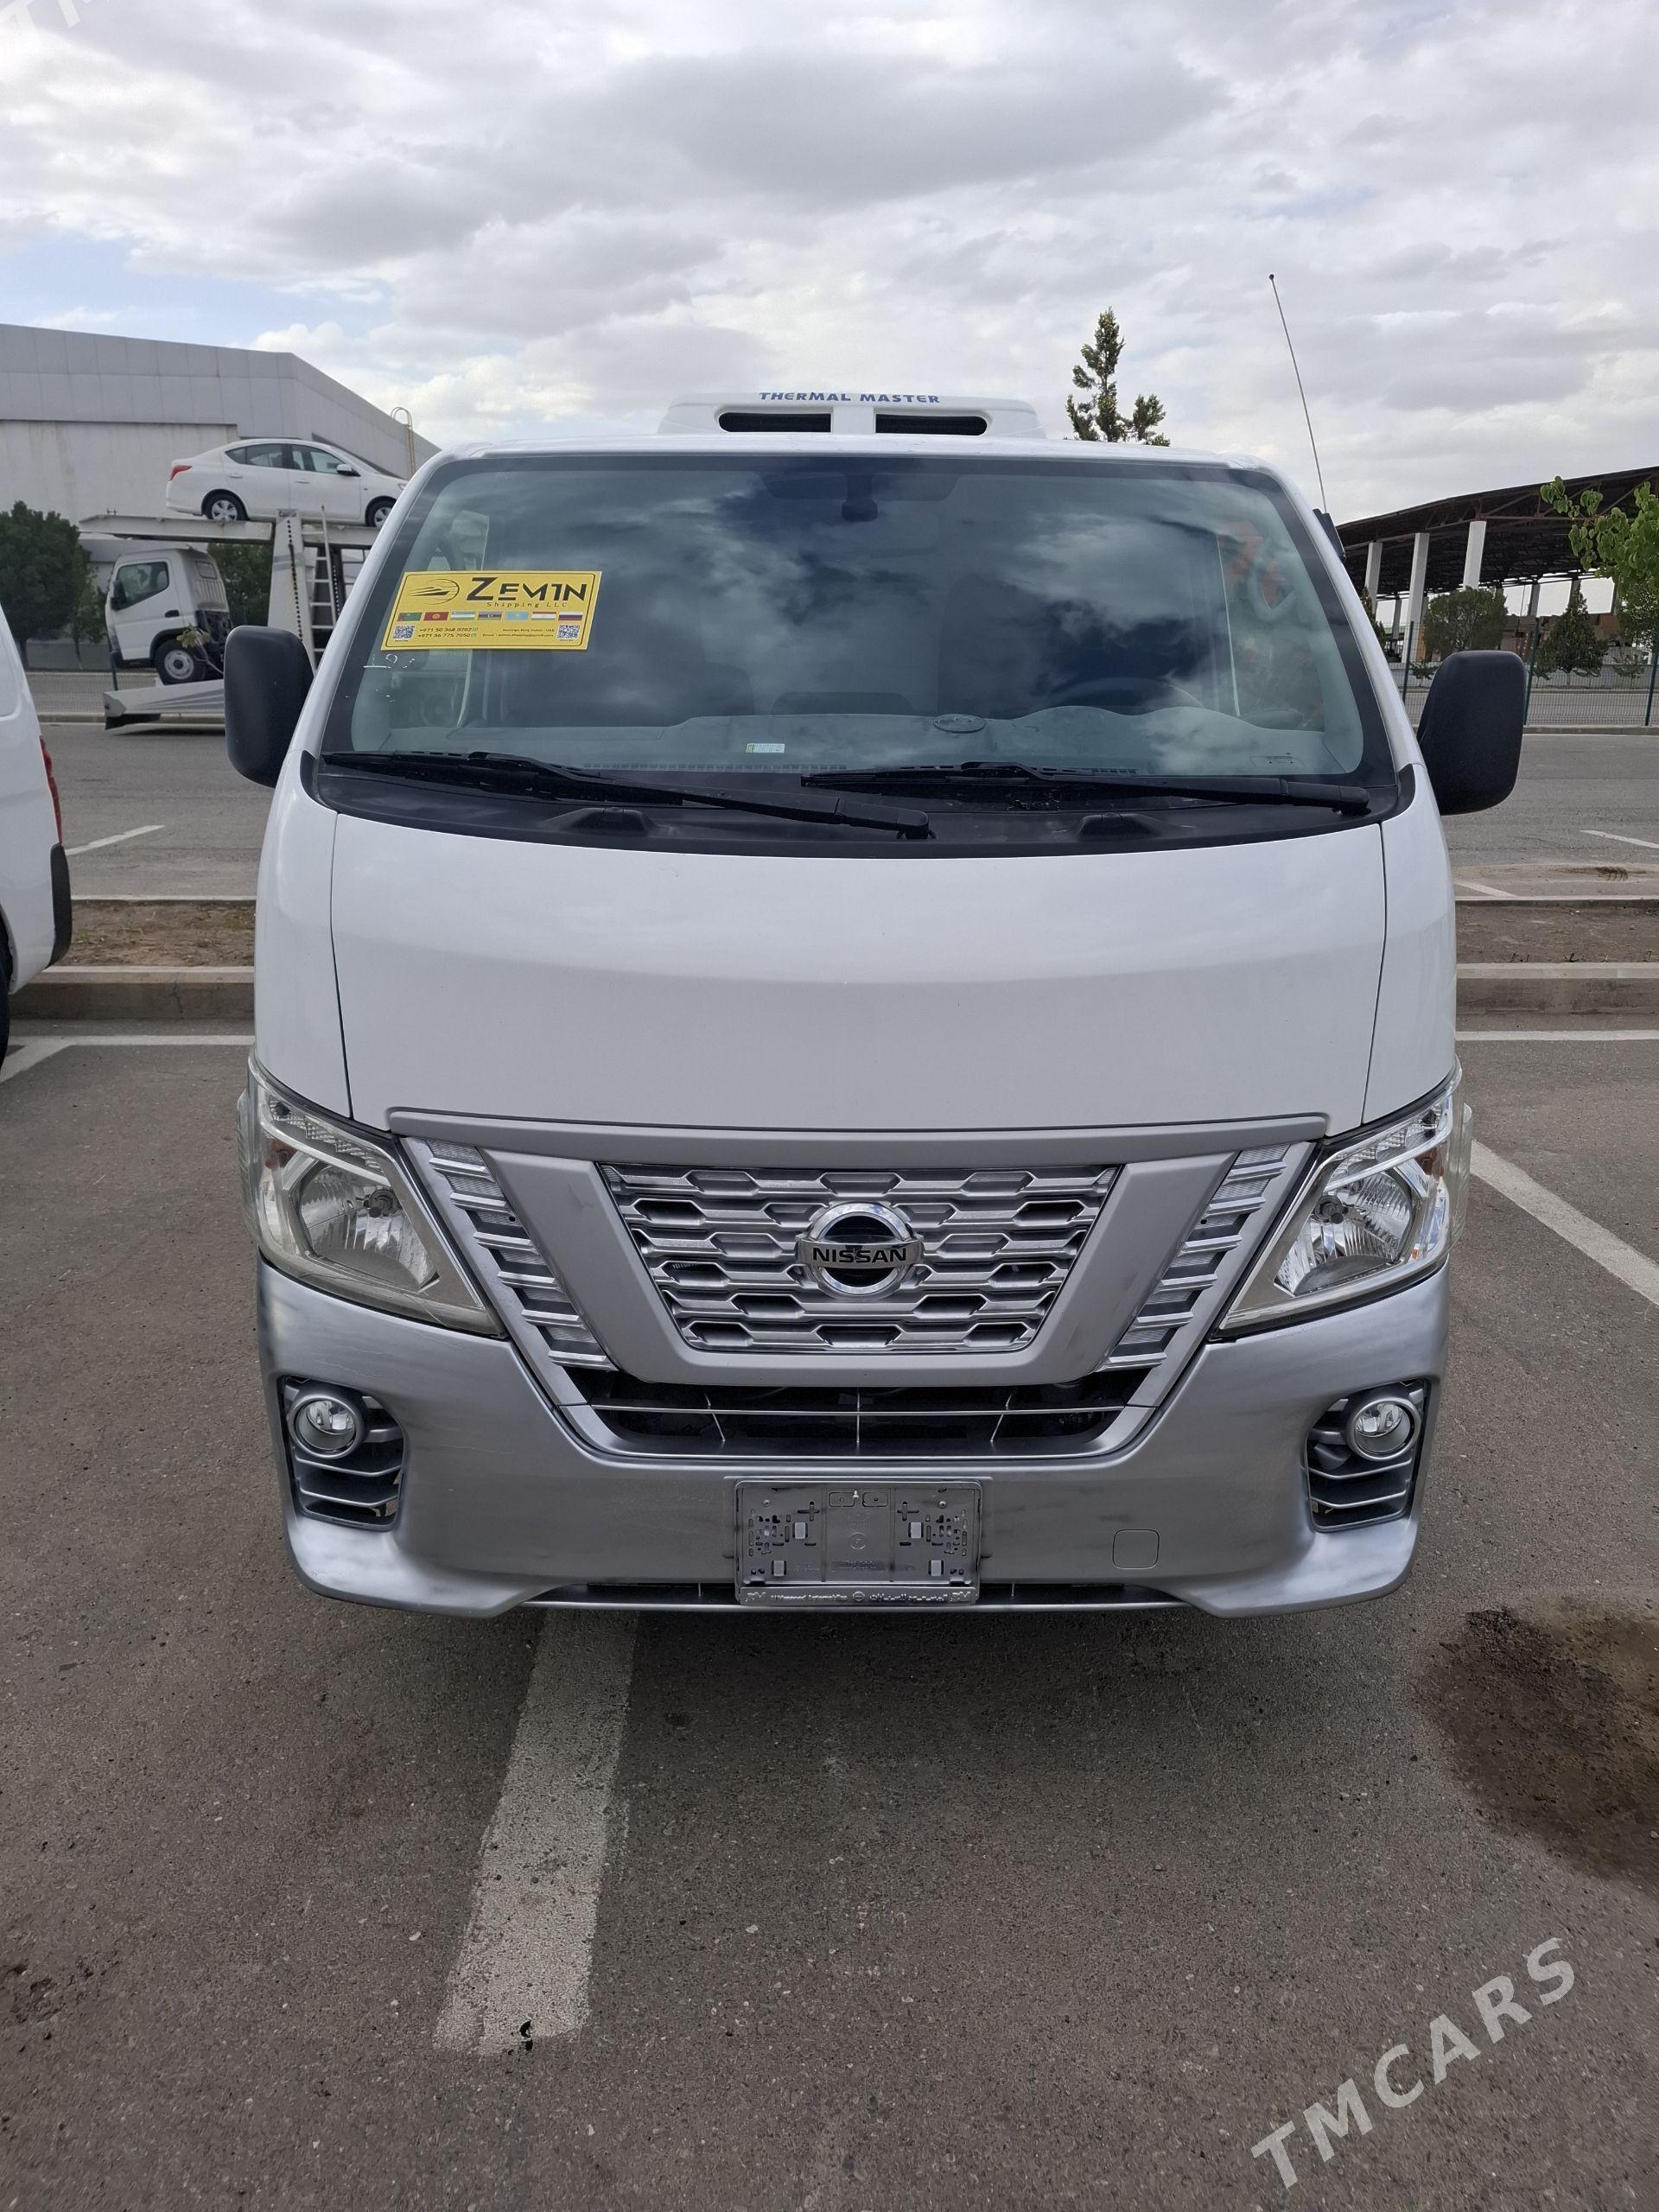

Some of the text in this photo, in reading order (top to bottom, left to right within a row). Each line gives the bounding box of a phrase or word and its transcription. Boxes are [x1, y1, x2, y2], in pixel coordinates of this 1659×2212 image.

[760, 391, 940, 404] THERMAL MASTER
[812, 1247, 906, 1263] NISSAN
